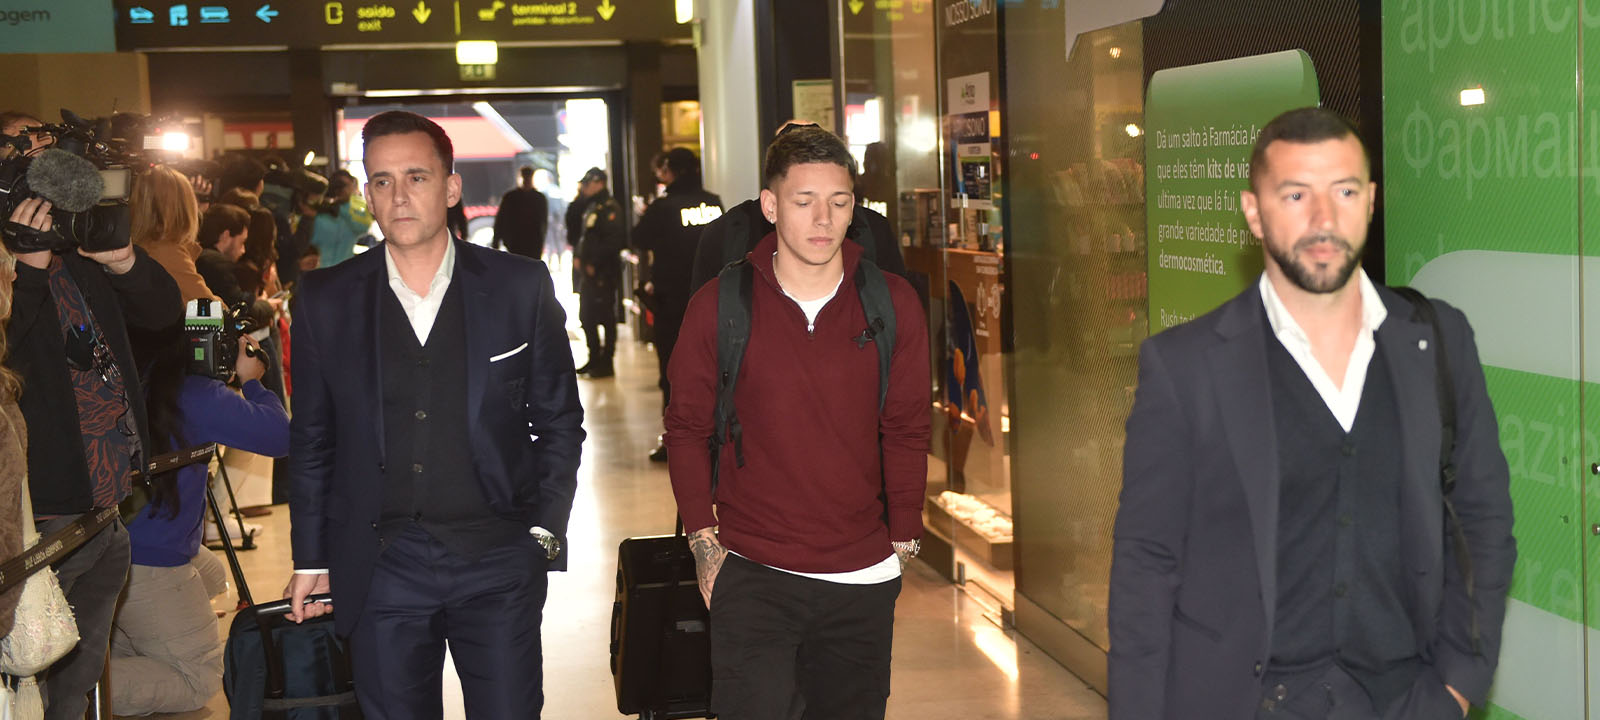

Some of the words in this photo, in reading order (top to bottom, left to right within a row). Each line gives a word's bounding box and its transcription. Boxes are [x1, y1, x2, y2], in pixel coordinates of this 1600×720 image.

[1156, 129, 1167, 149] Dá
[1168, 134, 1181, 148] um
[1182, 128, 1201, 148] salto
[1210, 123, 1248, 147] Farmácia
[1157, 163, 1171, 181] que
[1173, 160, 1188, 179] eles
[1189, 159, 1206, 179] têm
[1207, 158, 1222, 179] kits
[1224, 158, 1235, 179] de
[1182, 195, 1196, 210] vez
[1197, 195, 1213, 215] que
[1214, 190, 1222, 210] lá
[1224, 190, 1238, 215] fui,
[1158, 220, 1184, 242] grande
[1185, 222, 1225, 244] variedade
[1227, 223, 1238, 244] de
[1159, 249, 1227, 276] dermocosmética.
[1160, 307, 1178, 329] Rush
